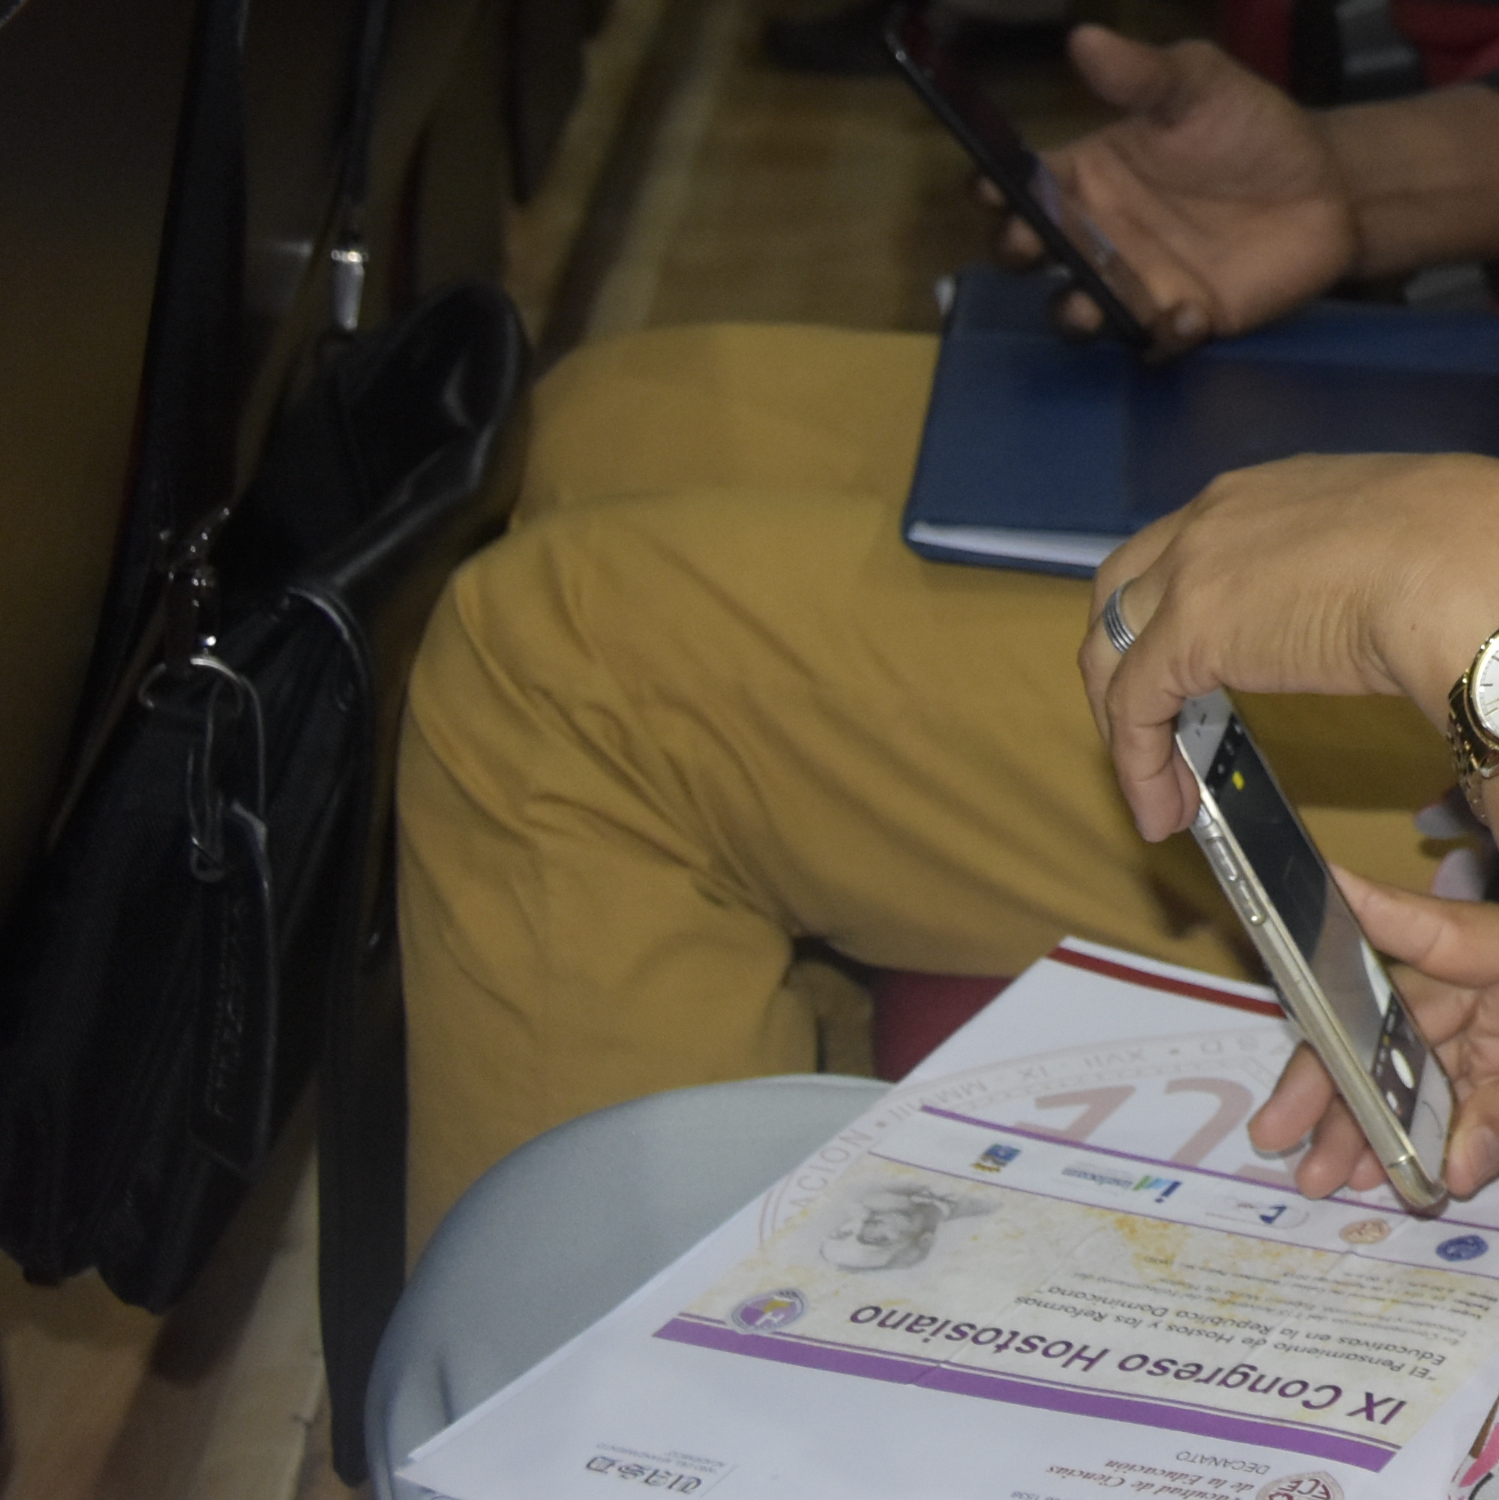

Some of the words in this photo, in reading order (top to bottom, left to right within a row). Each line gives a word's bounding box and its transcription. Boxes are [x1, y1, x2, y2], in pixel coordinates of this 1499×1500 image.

[1014, 1296, 1109, 1323] Reformas
[1114, 1314, 1144, 1329] las
[849, 1305, 1111, 1373] Hostosiano
[1165, 1323, 1235, 1344] Hostos
[1240, 1337, 1268, 1350] de
[1279, 1327, 1300, 1340] la
[1305, 1332, 1332, 1342] en
[1273, 1342, 1406, 1373] Pensamiento
[1338, 1337, 1447, 1366] Educativas
[1117, 1353, 1343, 1410] Congreso
[1346, 1391, 1407, 1426] IX
[1104, 1460, 1204, 1486] Educación
[1175, 1450, 1271, 1476] DECANATO
[1046, 1466, 1126, 1488] Ciencias
[1130, 1480, 1155, 1492] de
[1207, 1477, 1228, 1490] la
[1230, 1481, 1255, 1494] de
[1152, 1485, 1242, 1500] acultad
